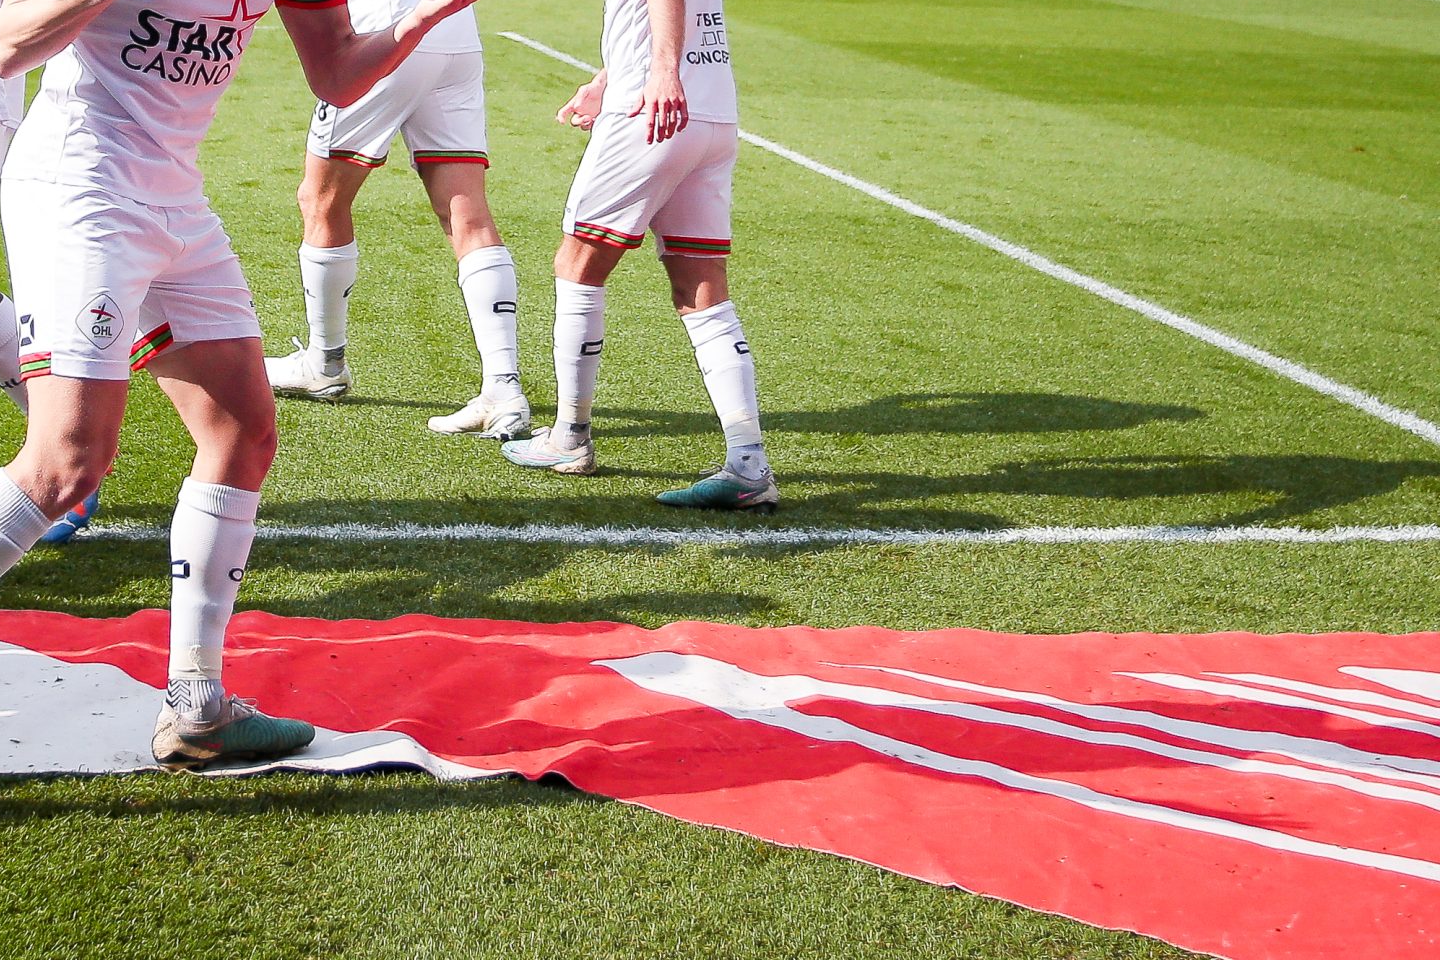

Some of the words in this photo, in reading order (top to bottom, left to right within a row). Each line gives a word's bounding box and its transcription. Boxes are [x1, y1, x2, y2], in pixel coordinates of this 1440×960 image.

[130, 9, 237, 62] STAR
[120, 44, 231, 87] CASINO
[91, 325, 112, 336] OHL
